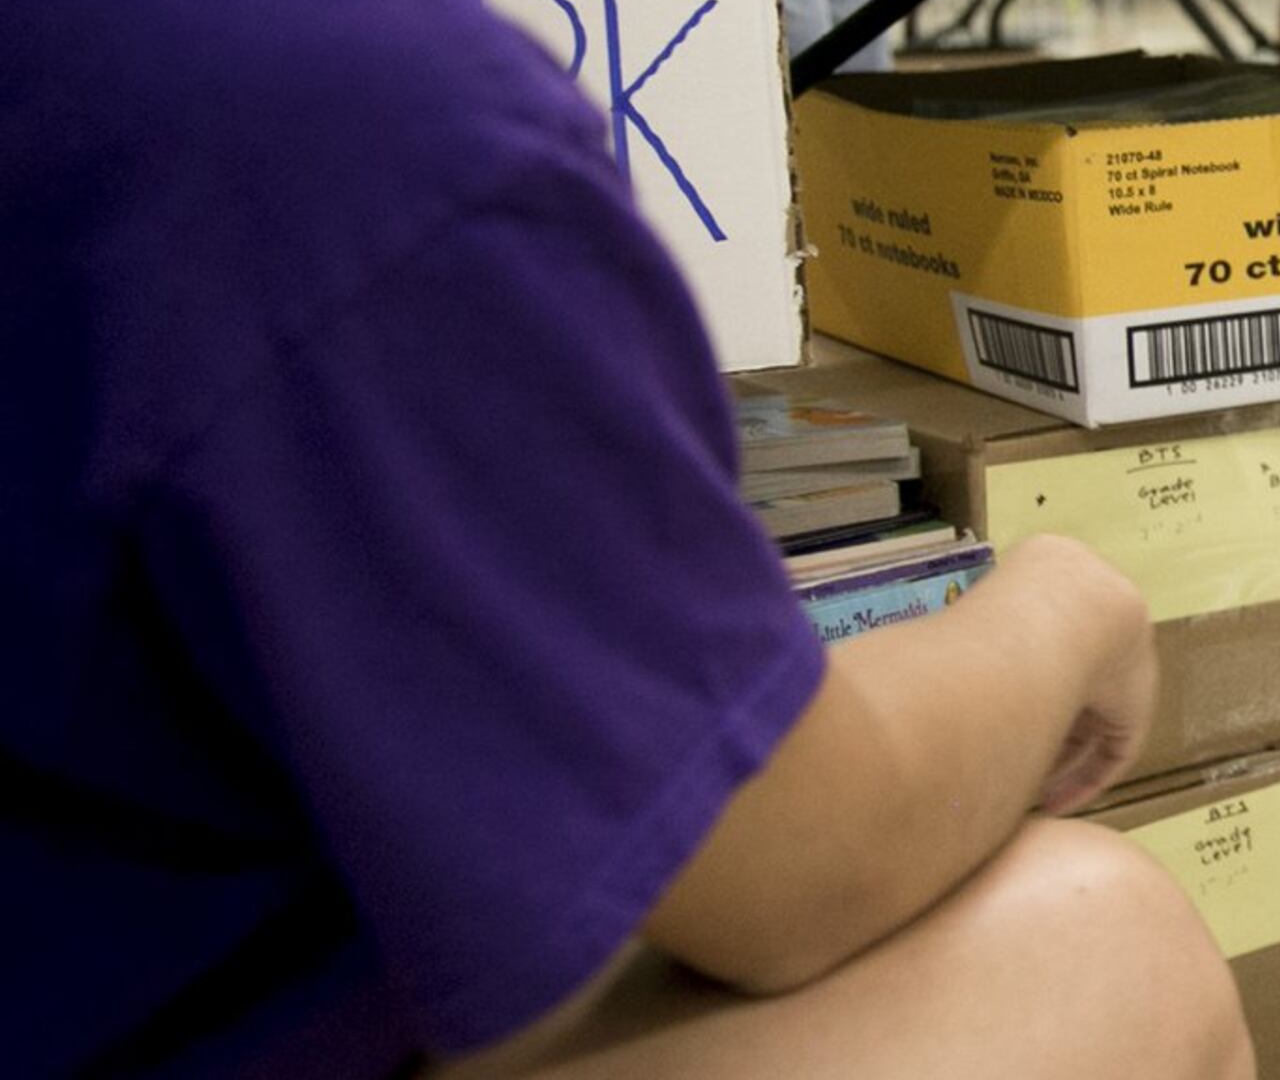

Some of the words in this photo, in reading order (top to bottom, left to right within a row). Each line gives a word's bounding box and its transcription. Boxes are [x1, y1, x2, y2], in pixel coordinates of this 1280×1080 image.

[1107, 150, 1163, 166] 21070-48
[1107, 171, 1122, 182] 70
[1125, 170, 1138, 181] ct
[1141, 166, 1178, 180] Spiral
[1181, 158, 1240, 176] Notebook
[1109, 187, 1135, 199] 10.5
[1138, 187, 1146, 197] x
[852, 196, 884, 224] wide
[888, 209, 932, 236] ruled
[1108, 204, 1141, 217] Wide
[1144, 200, 1173, 214] Rule
[876, 240, 961, 280] notebooks
[1185, 260, 1232, 287] 70
[1138, 446, 1183, 464] BTS
[1138, 477, 1194, 499] Grade
[1149, 492, 1196, 510] Level
[1201, 839, 1252, 866] Level
